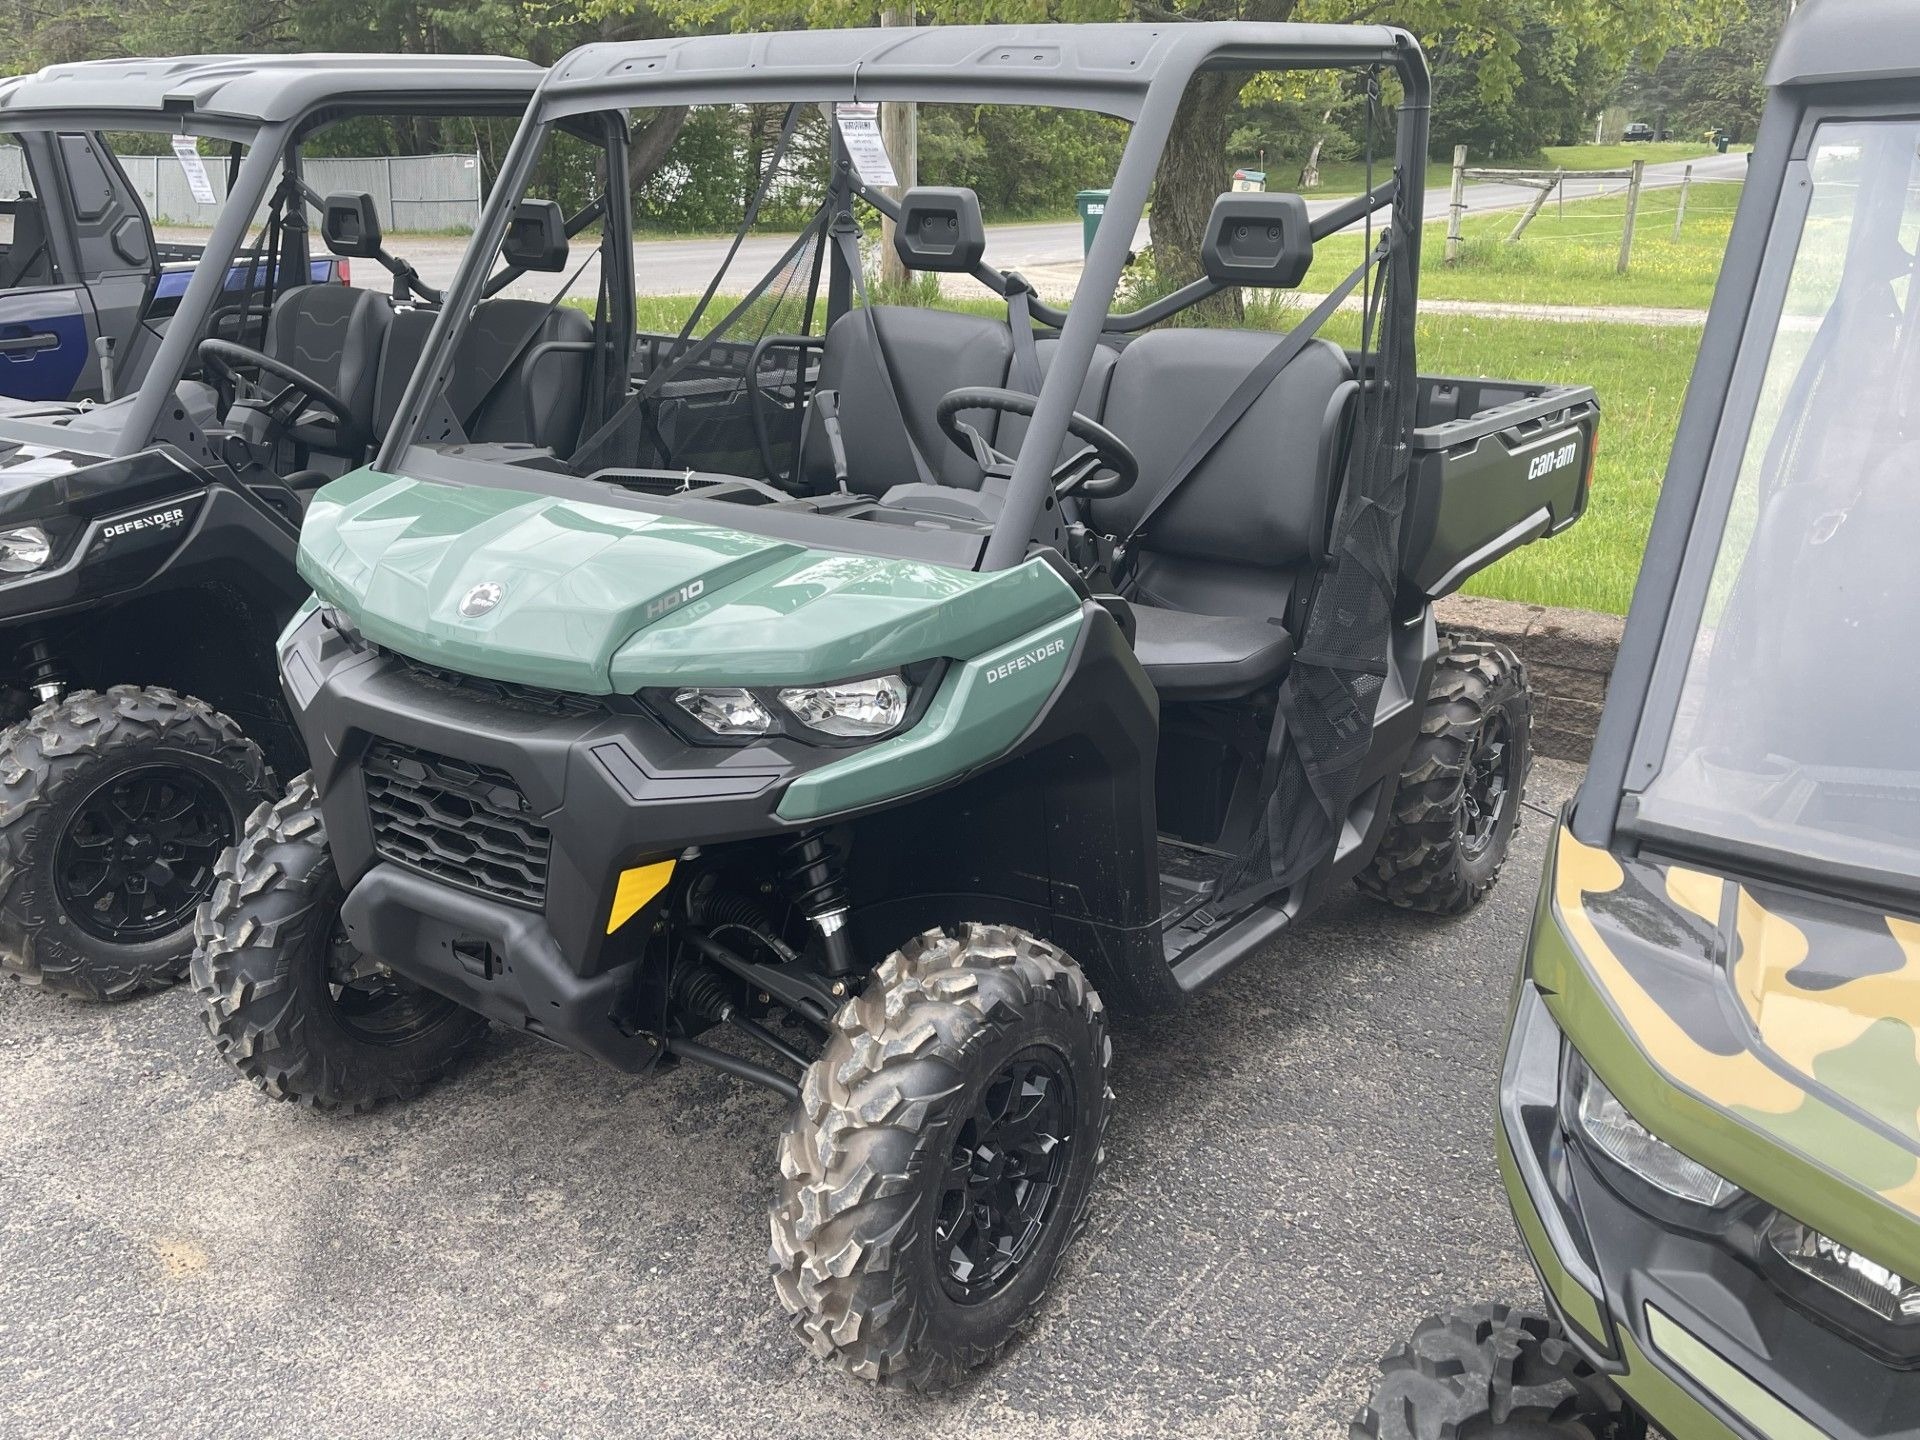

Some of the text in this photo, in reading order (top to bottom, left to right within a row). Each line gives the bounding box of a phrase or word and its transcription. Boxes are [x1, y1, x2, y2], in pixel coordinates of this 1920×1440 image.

[103, 509, 184, 538] DEFENDER
[160, 518, 184, 531] XT
[647, 580, 704, 619] HD10
[986, 639, 1065, 684] DEFENDER
